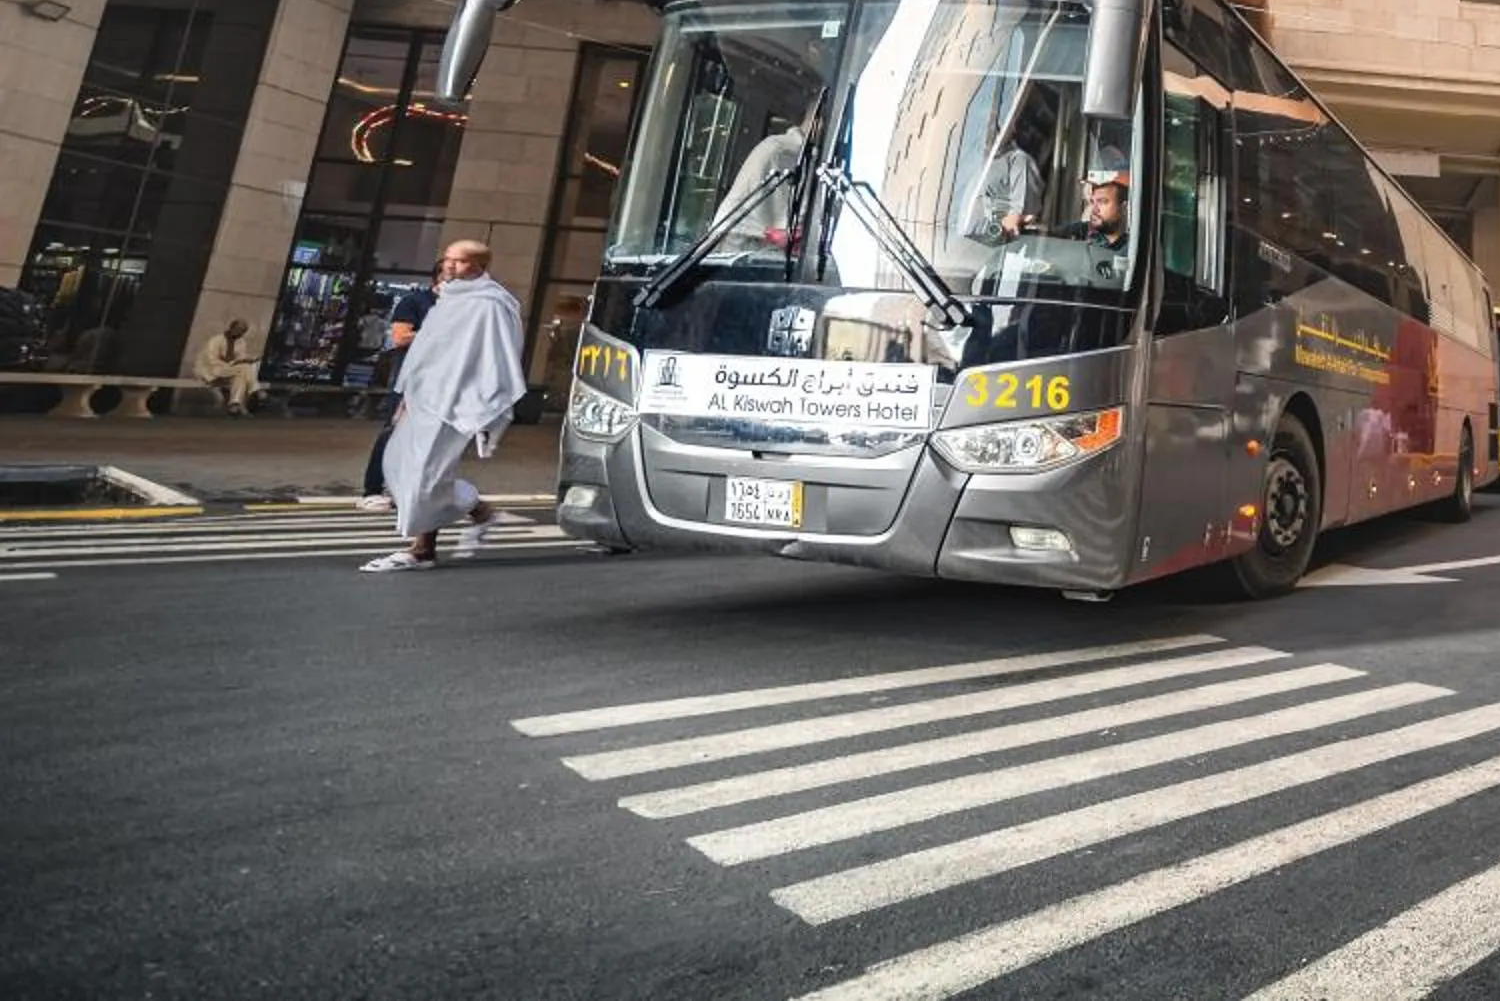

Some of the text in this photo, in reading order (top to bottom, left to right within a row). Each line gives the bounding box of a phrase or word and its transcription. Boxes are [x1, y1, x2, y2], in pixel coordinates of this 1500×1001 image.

[715, 364, 920, 396] فندق أبراج الكسوة
[966, 372, 1070, 411] 3216
[733, 394, 793, 415] Kiswah
[800, 397, 861, 417] Towers
[867, 400, 919, 421] Hotel
